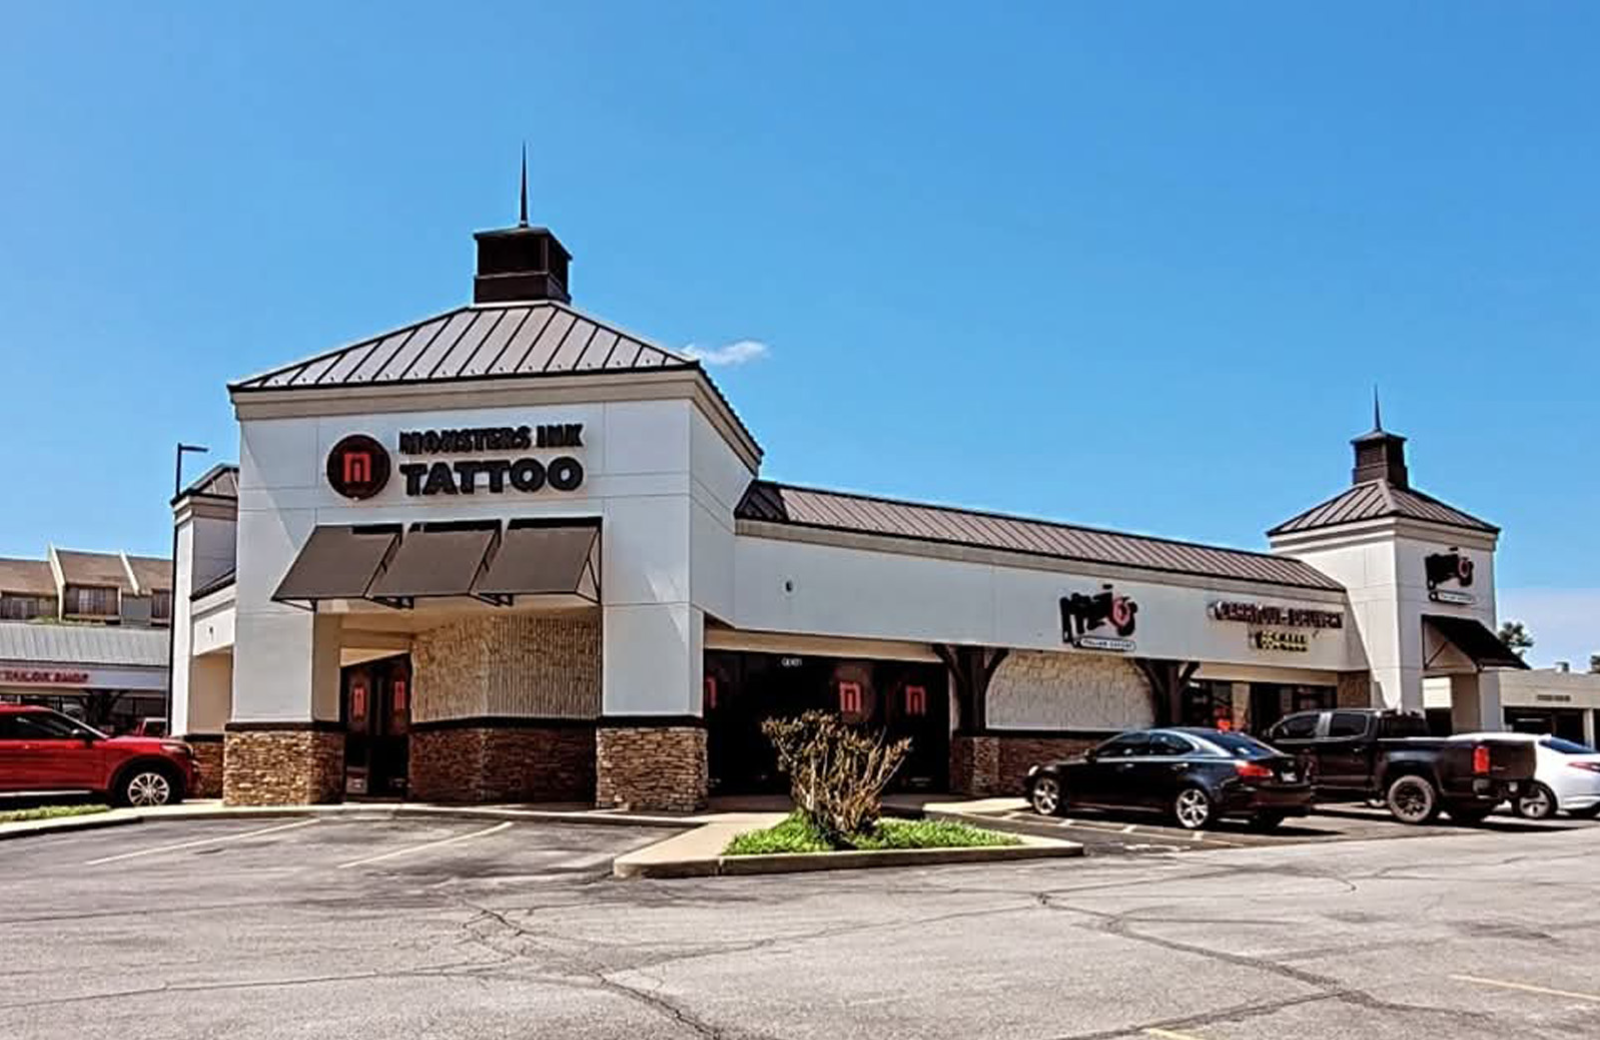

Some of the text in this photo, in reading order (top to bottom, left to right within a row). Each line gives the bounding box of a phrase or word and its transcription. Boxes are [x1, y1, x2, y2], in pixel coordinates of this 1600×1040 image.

[400, 424, 583, 454] MONSTERS INK
[400, 456, 583, 495] TATTOO
